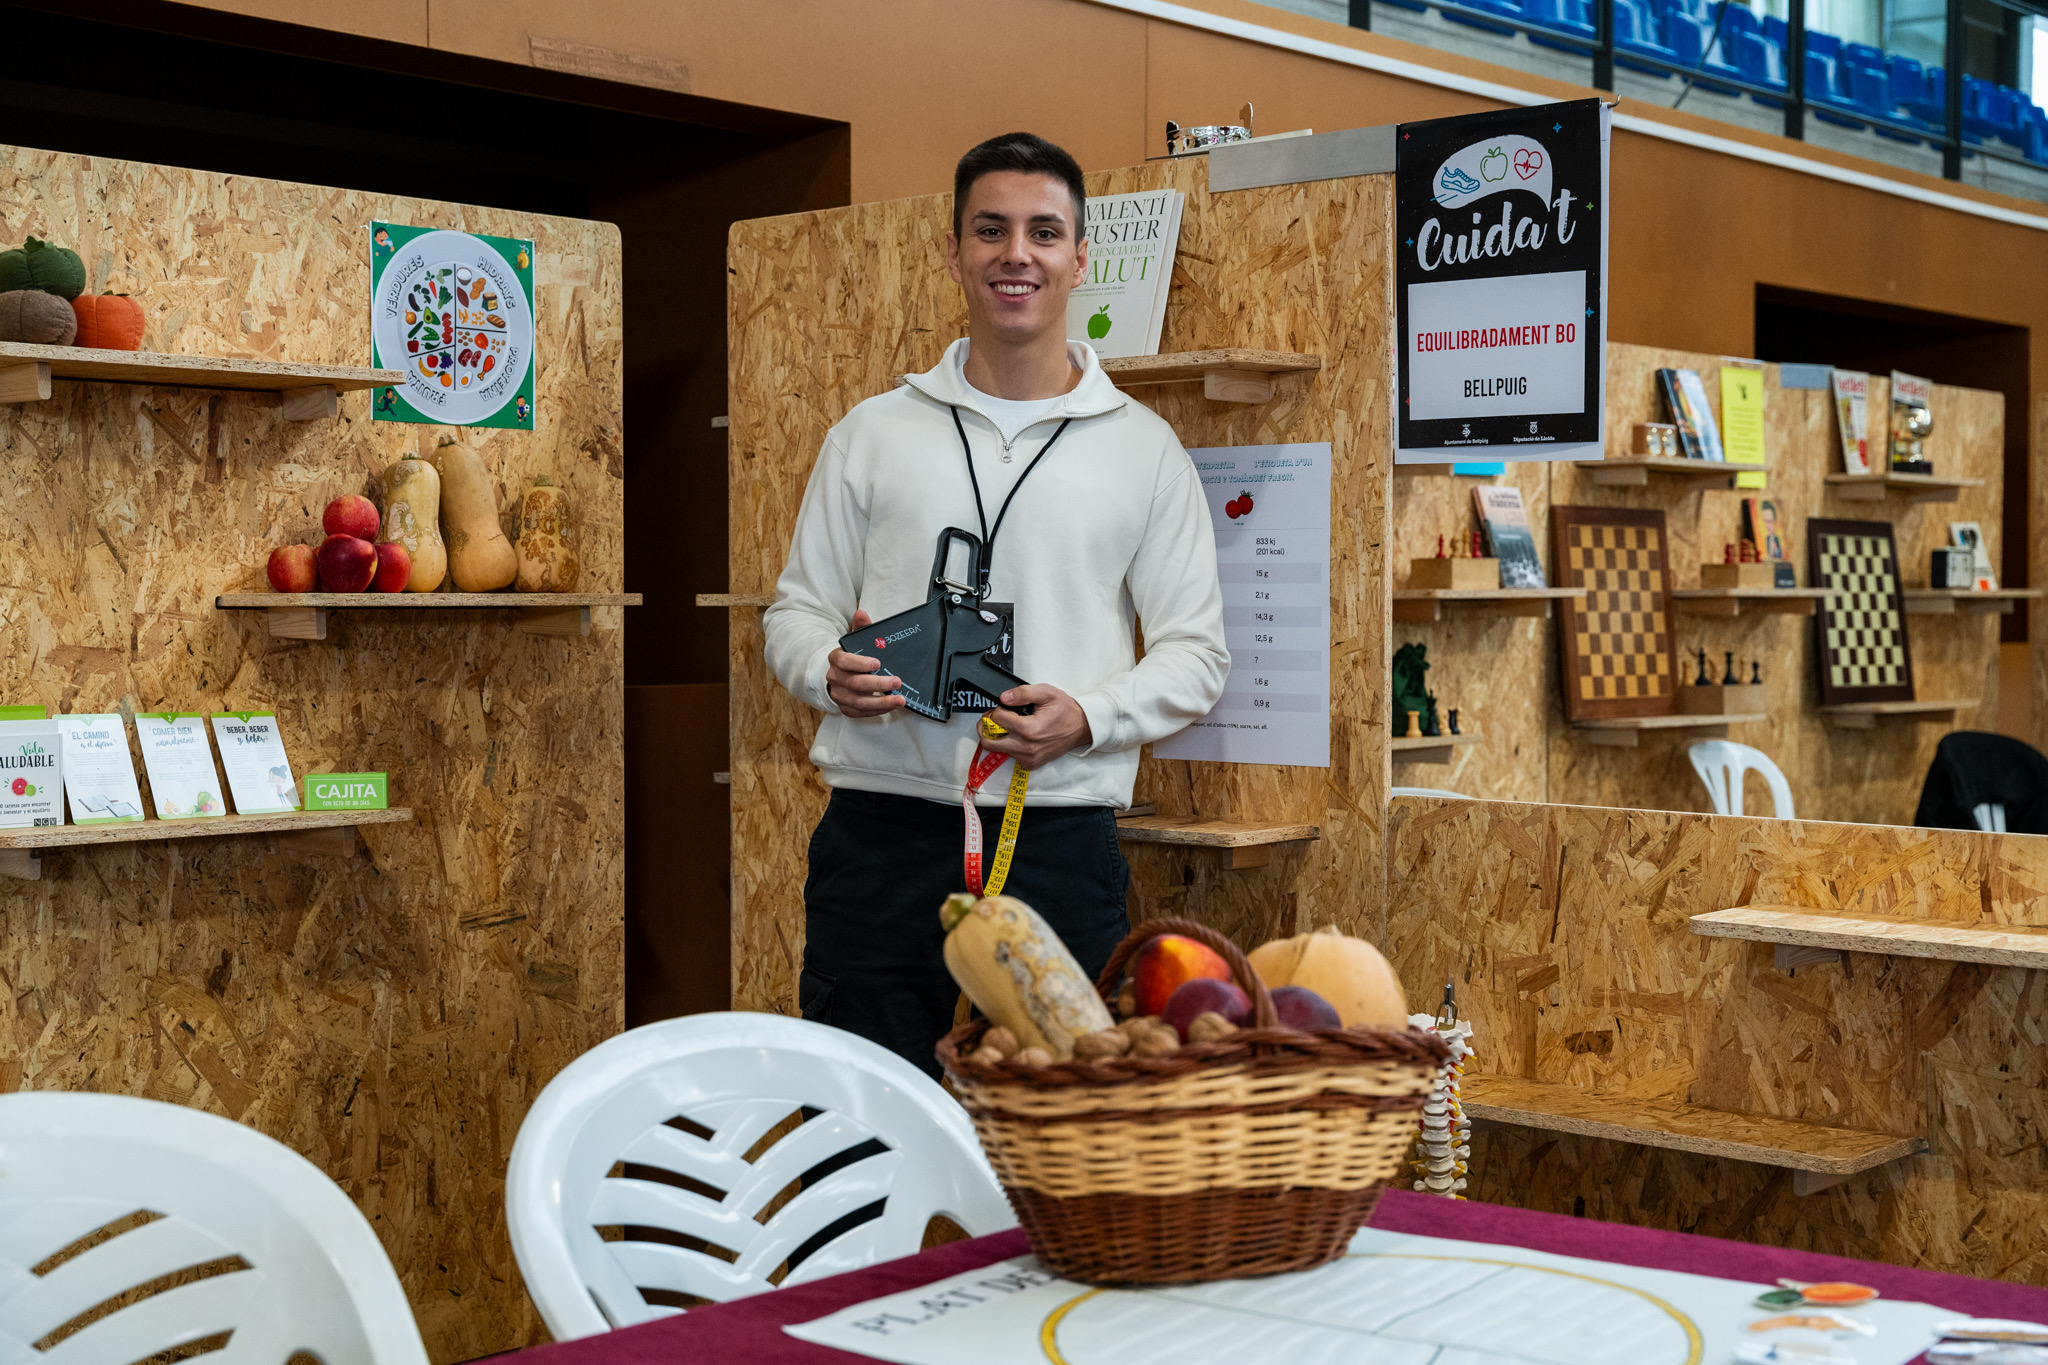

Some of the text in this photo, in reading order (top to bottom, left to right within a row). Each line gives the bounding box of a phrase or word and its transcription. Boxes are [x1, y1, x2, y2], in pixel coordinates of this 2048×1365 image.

[1086, 193, 1168, 221] VALENTÍ
[1084, 219, 1159, 244] FUSTER
[1089, 243, 1156, 258] CIÈNCIA DE LA
[1084, 256, 1155, 284] ALUT
[386, 255, 424, 319] VERDURES
[477, 256, 516, 309] HIDRATS
[1417, 323, 1577, 352] EQUILIBRADAMENT BO
[405, 370, 447, 406] FRUITA
[1464, 377, 1527, 398] BELLPUIG
[1195, 461, 1235, 470] NTERPRETAR
[1229, 473, 1266, 483] TOMÀQUET
[1255, 537, 1276, 546] 833 kj
[1255, 547, 1285, 556] (201 kcal)
[1255, 569, 1263, 577] 15
[1255, 591, 1270, 600] 2,1 g
[1255, 613, 1274, 622] 14,3 g
[1254, 634, 1268, 642] 12,5
[1254, 677, 1263, 686] 1,6
[1254, 699, 1264, 707] 0,9
[152, 726, 193, 736] COMER BIEN
[226, 725, 269, 734] BEBER, BEBER
[72, 731, 109, 740] EL CAMINO
[245, 734, 266, 744] beber
[19, 741, 45, 756] Vida
[0, 754, 55, 769] ALUDABLE
[315, 783, 378, 799] CAJITA
